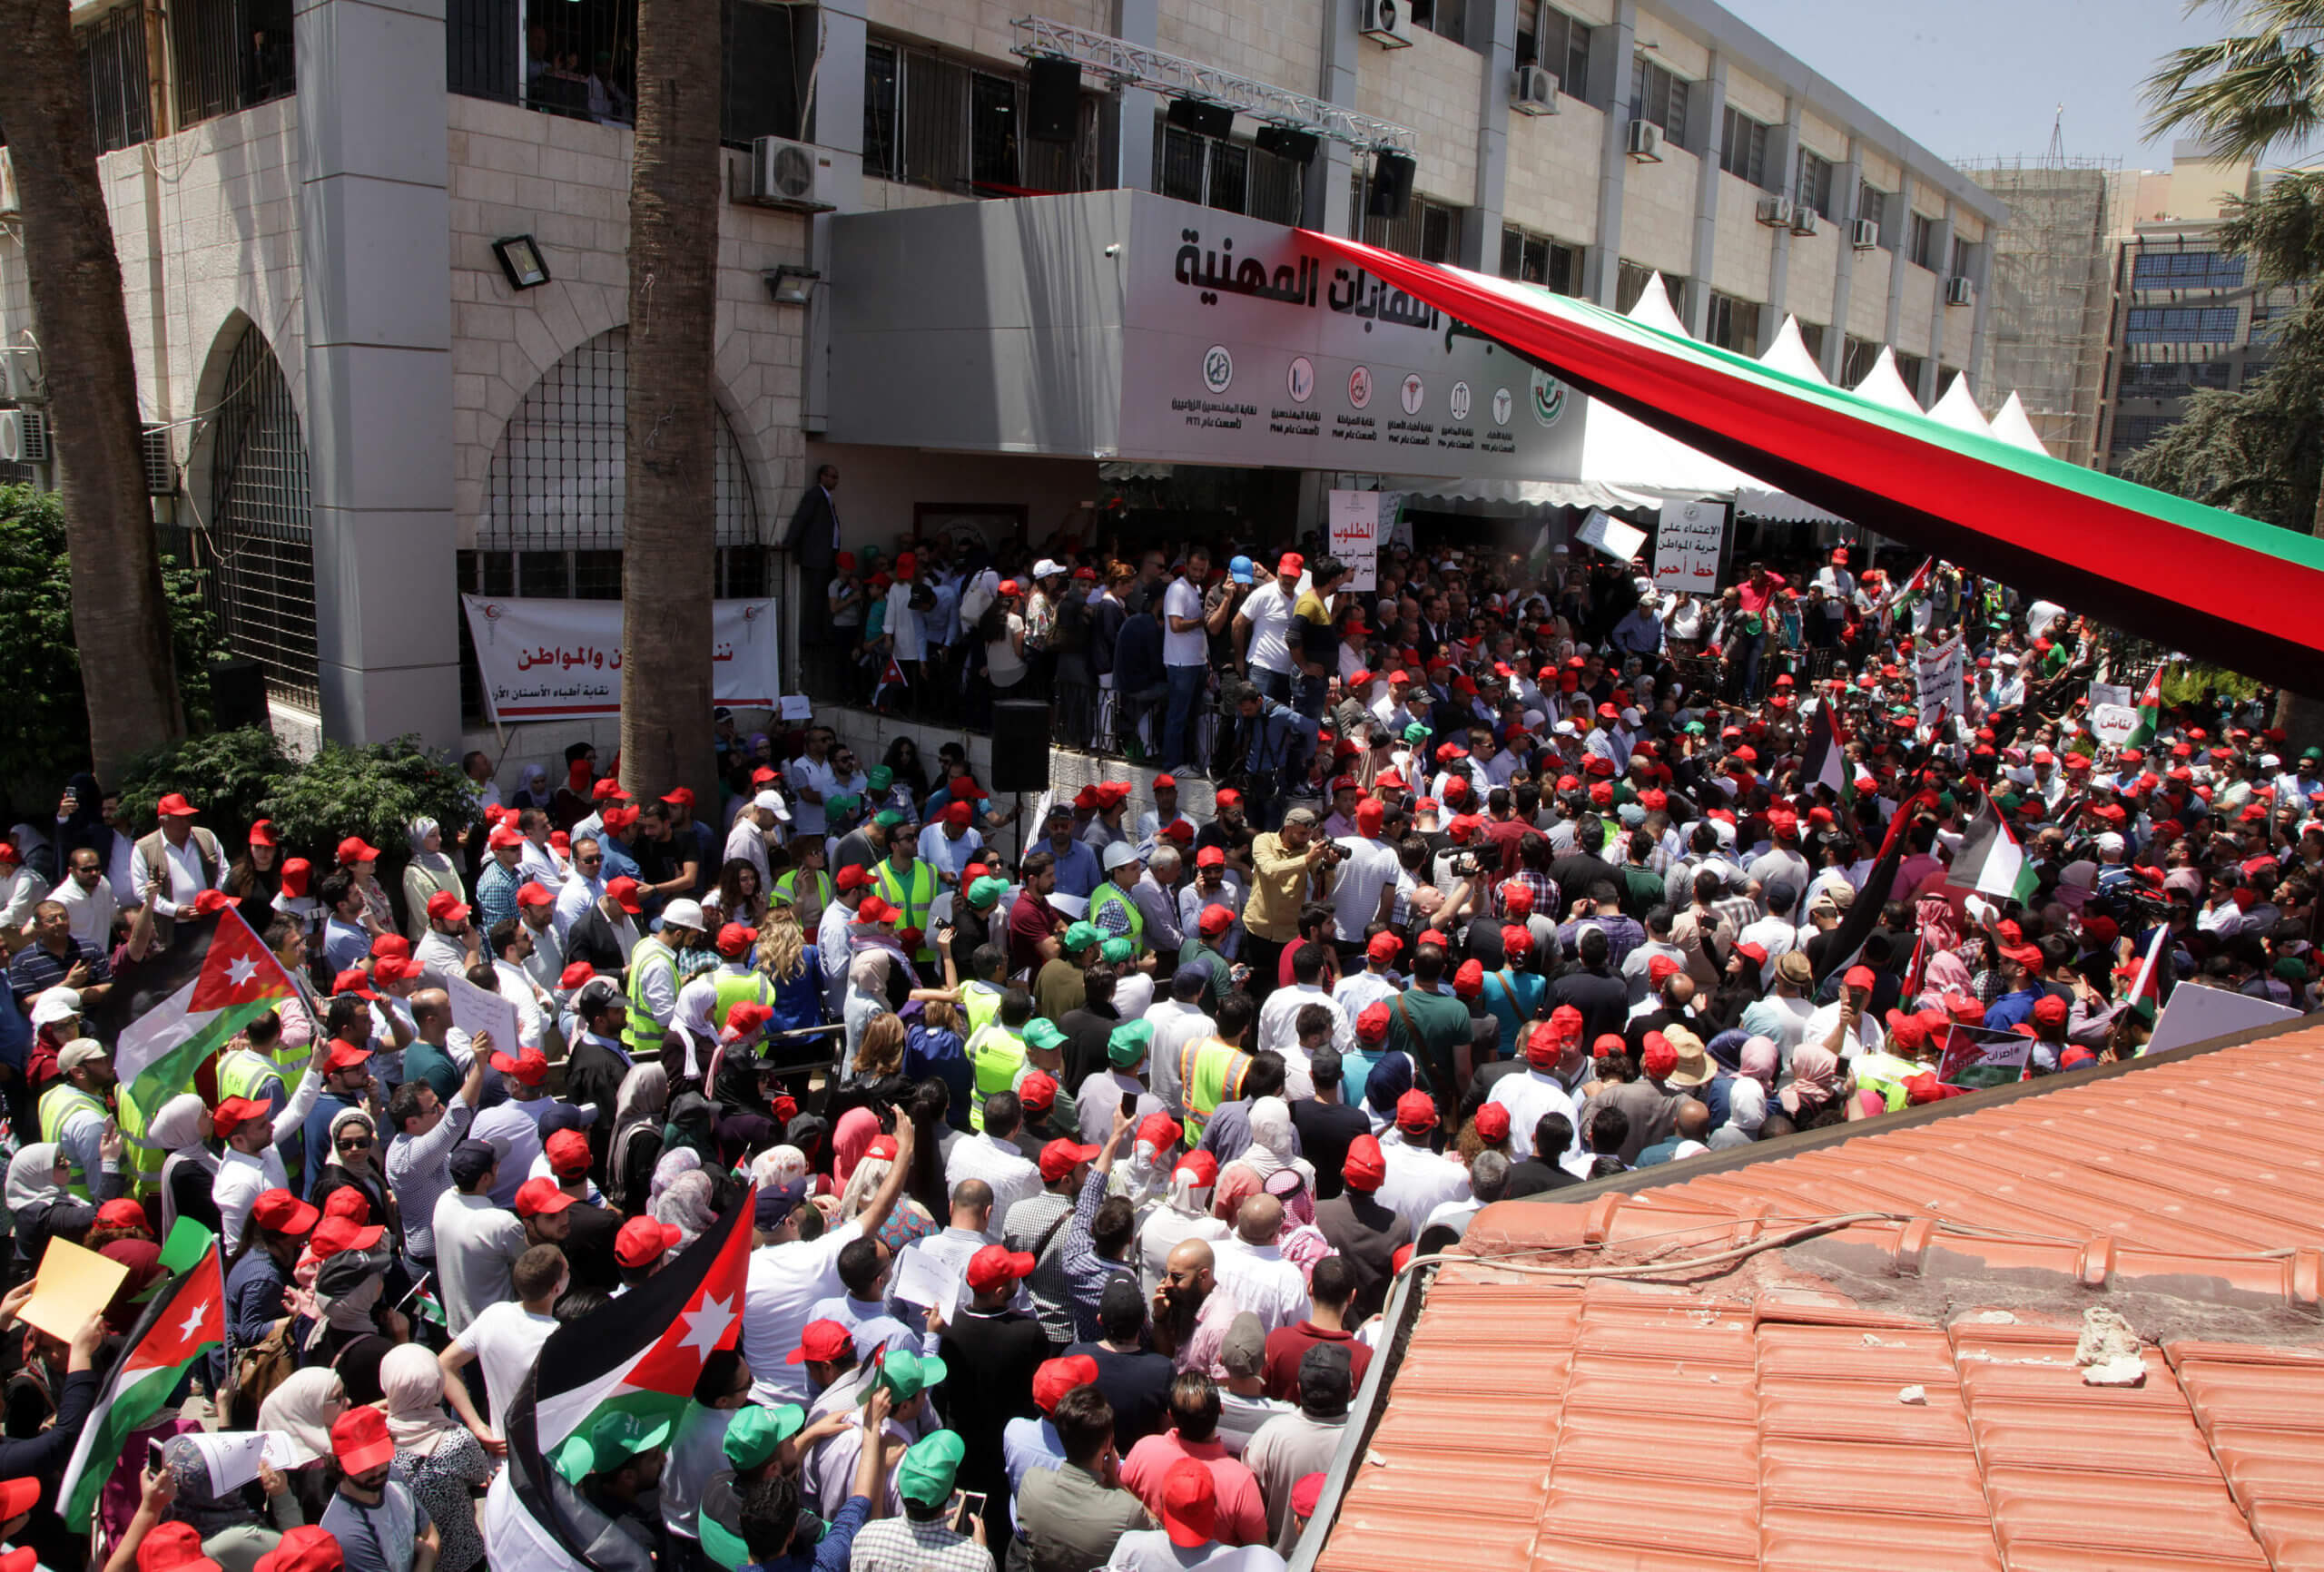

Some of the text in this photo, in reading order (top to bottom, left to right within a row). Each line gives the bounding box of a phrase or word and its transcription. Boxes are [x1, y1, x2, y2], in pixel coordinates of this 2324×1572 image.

[1176, 228, 1319, 308] المهنية
[1202, 399, 1240, 414] المهندسين
[1241, 404, 1257, 417] نقابة
[1271, 408, 1321, 422] نقابة المهندسين
[1333, 522, 1374, 545] المطلوب
[1660, 522, 1681, 535] على
[1658, 537, 1718, 555] حرية المواطن
[1655, 555, 1715, 579] خط أحمر
[517, 645, 603, 672] والمواطن
[511, 683, 550, 702] الأسنان
[553, 683, 580, 701] أطباء
[583, 684, 610, 700] نقابة
